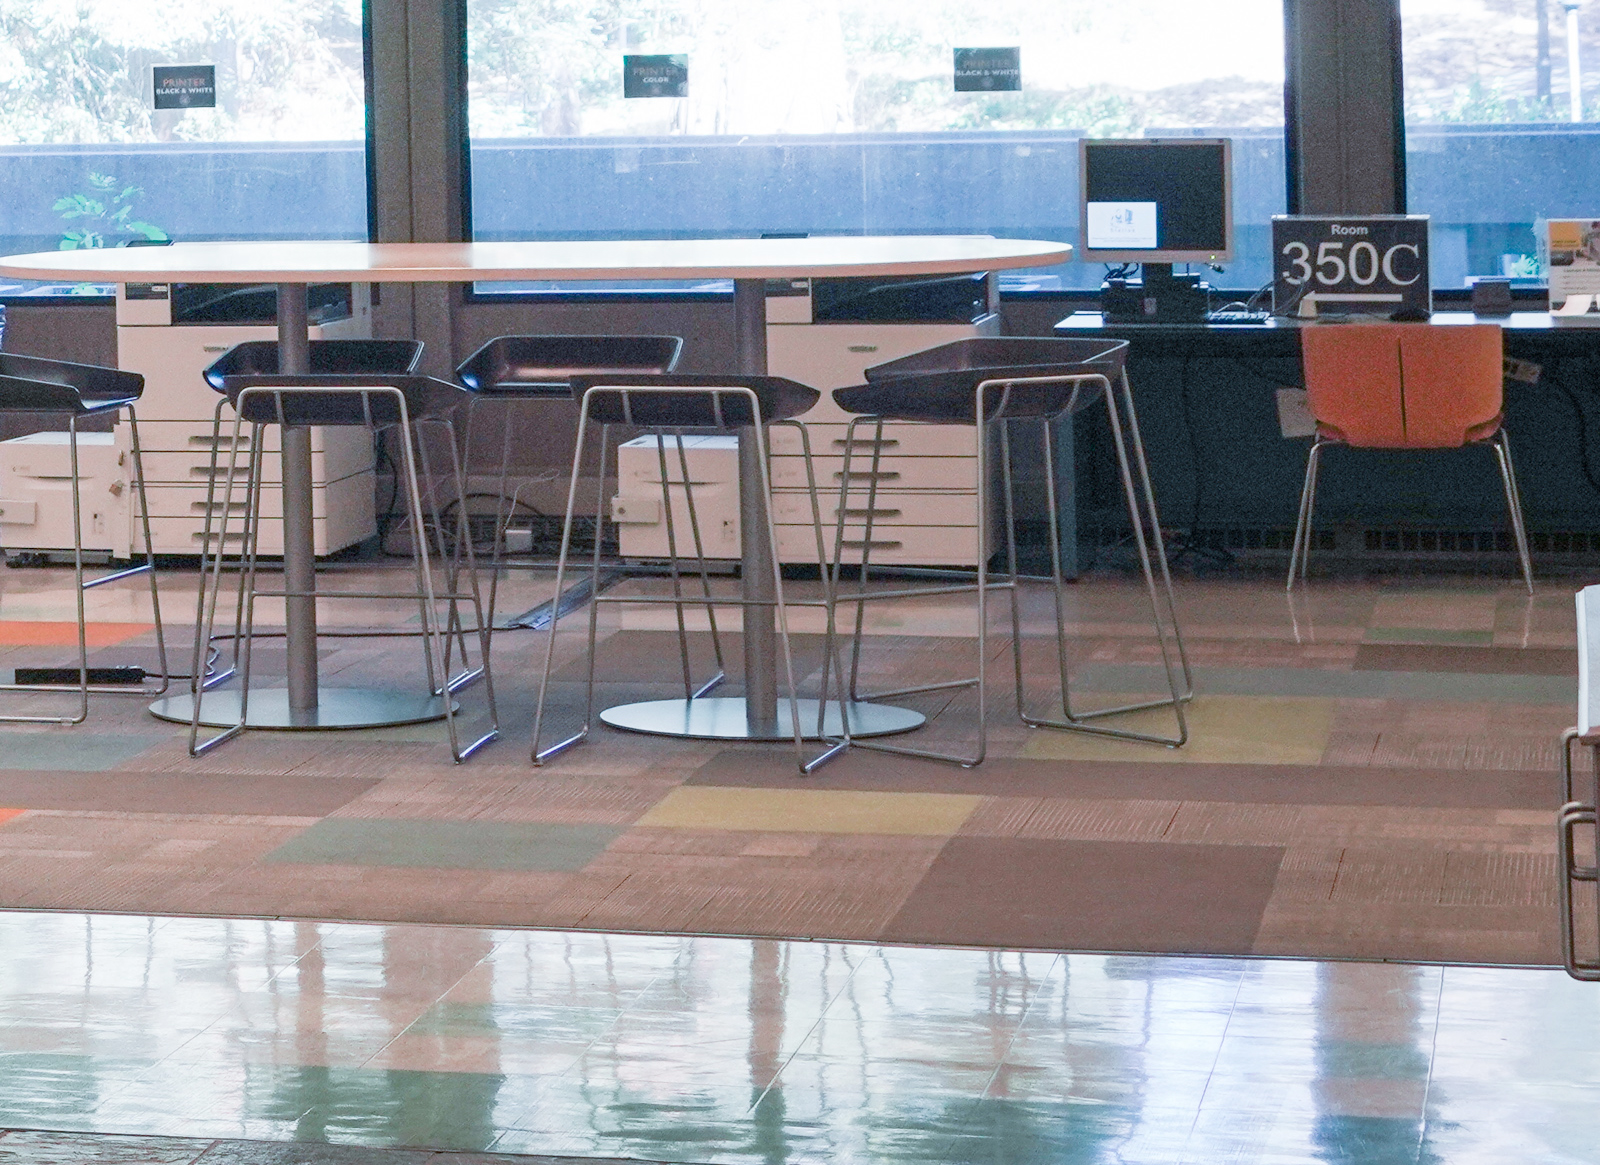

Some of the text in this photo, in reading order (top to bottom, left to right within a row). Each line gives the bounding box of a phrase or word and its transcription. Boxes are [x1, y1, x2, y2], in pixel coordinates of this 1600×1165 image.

[162, 78, 205, 87] PRINTER
[155, 87, 180, 95] BLACK
[1331, 223, 1369, 236] Room
[1282, 240, 1421, 286] 350C
